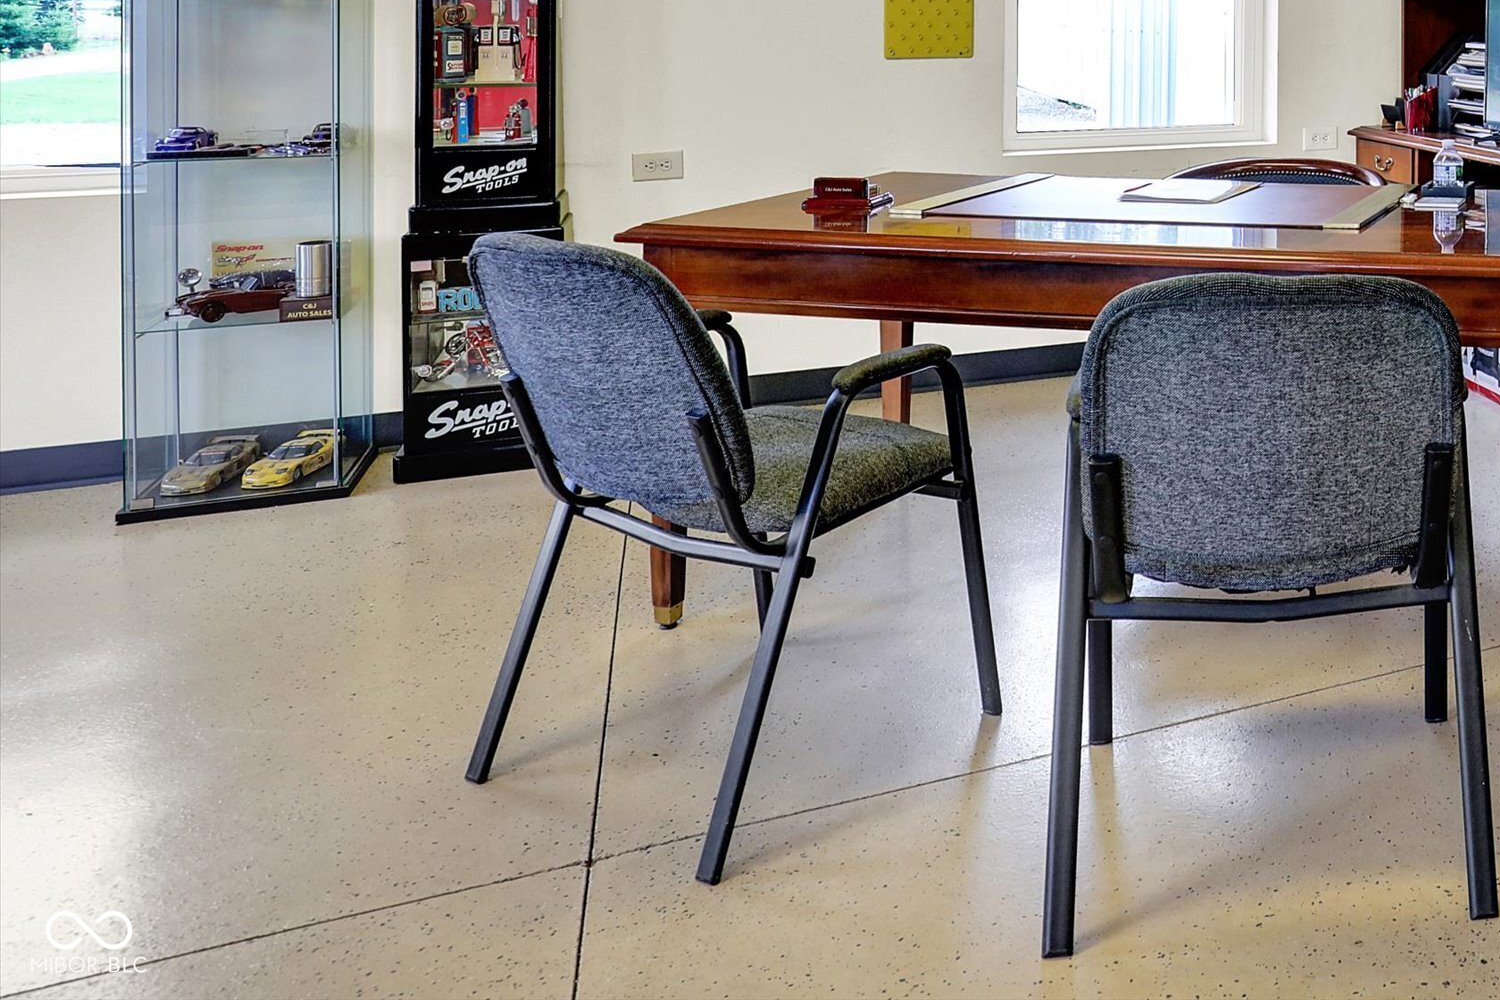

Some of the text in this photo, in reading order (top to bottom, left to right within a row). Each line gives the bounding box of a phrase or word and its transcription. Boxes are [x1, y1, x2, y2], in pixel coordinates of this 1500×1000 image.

[441, 157, 528, 194] Snap-on
[475, 174, 520, 194] TOOLS
[213, 243, 265, 253] Snap-on
[287, 310, 309, 318] AUTO
[424, 399, 511, 439] Snap
[472, 417, 520, 439] TOOL
